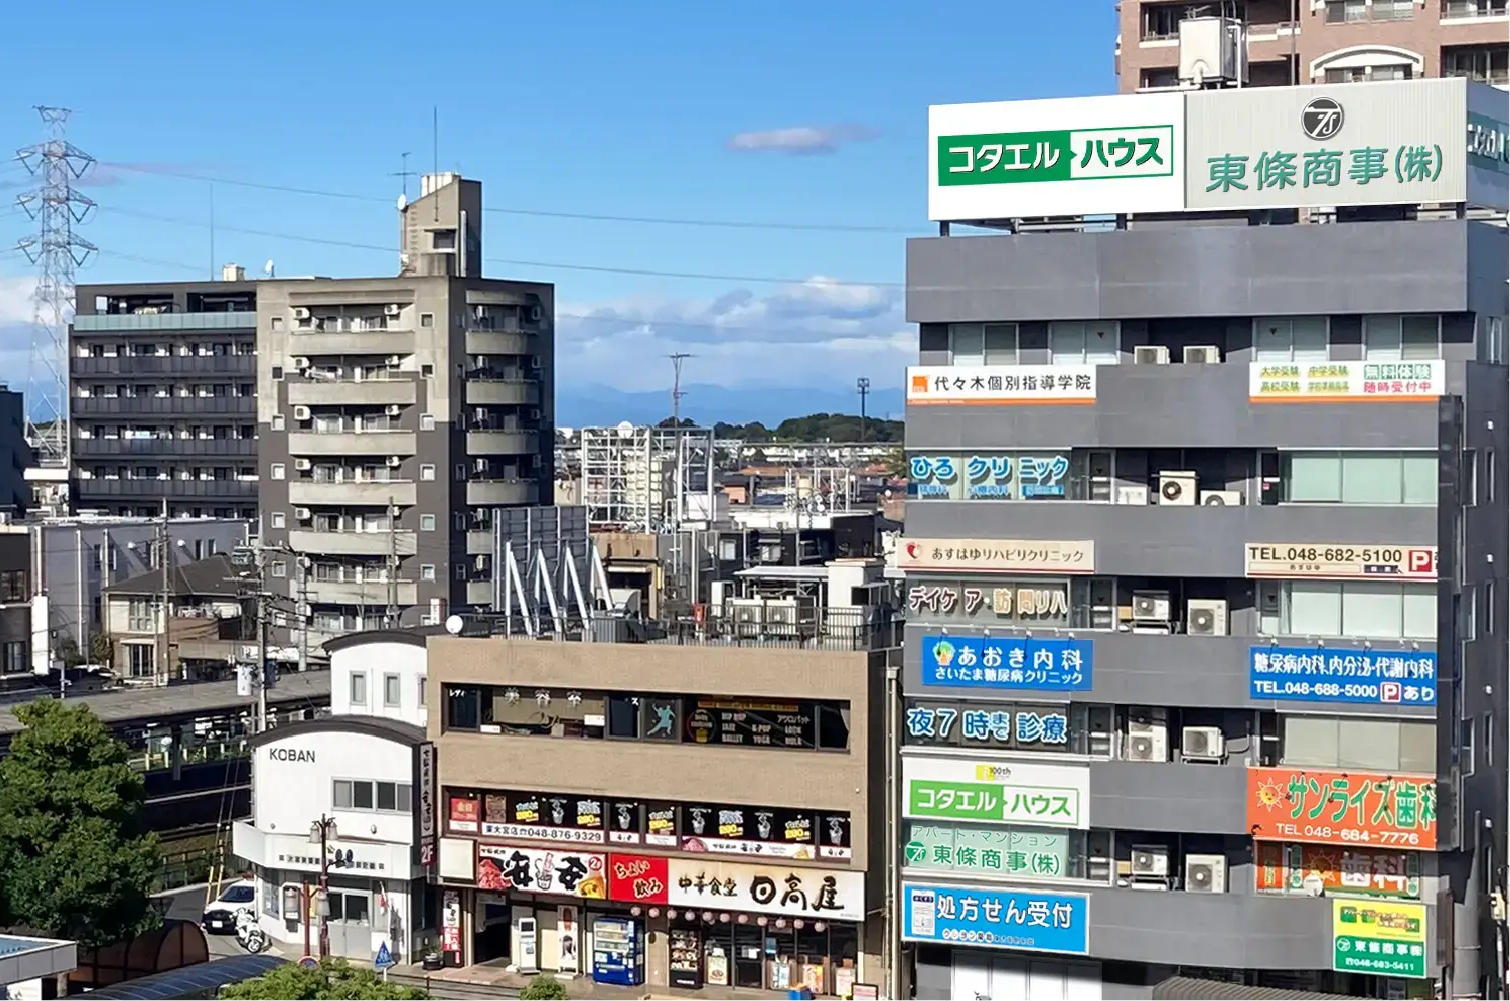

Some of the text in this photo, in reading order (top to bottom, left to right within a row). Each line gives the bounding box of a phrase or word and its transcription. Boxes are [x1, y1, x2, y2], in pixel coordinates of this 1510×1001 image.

[949, 137, 1164, 173] コタエルハウス
[934, 375, 1092, 391] 代々木個別指導学院
[1363, 381, 1432, 393] 随時受付中
[957, 645, 1083, 672] あおき内科
[935, 667, 1083, 685] さいたま糖尿病クリニック
[1403, 686, 1434, 701] あり
[269, 748, 316, 763] KOBAN
[918, 787, 1071, 817] コタエルハウス
[421, 846, 433, 862] 2F
[749, 873, 845, 912] 日高屋
[937, 894, 1073, 929] 処方せん受付
